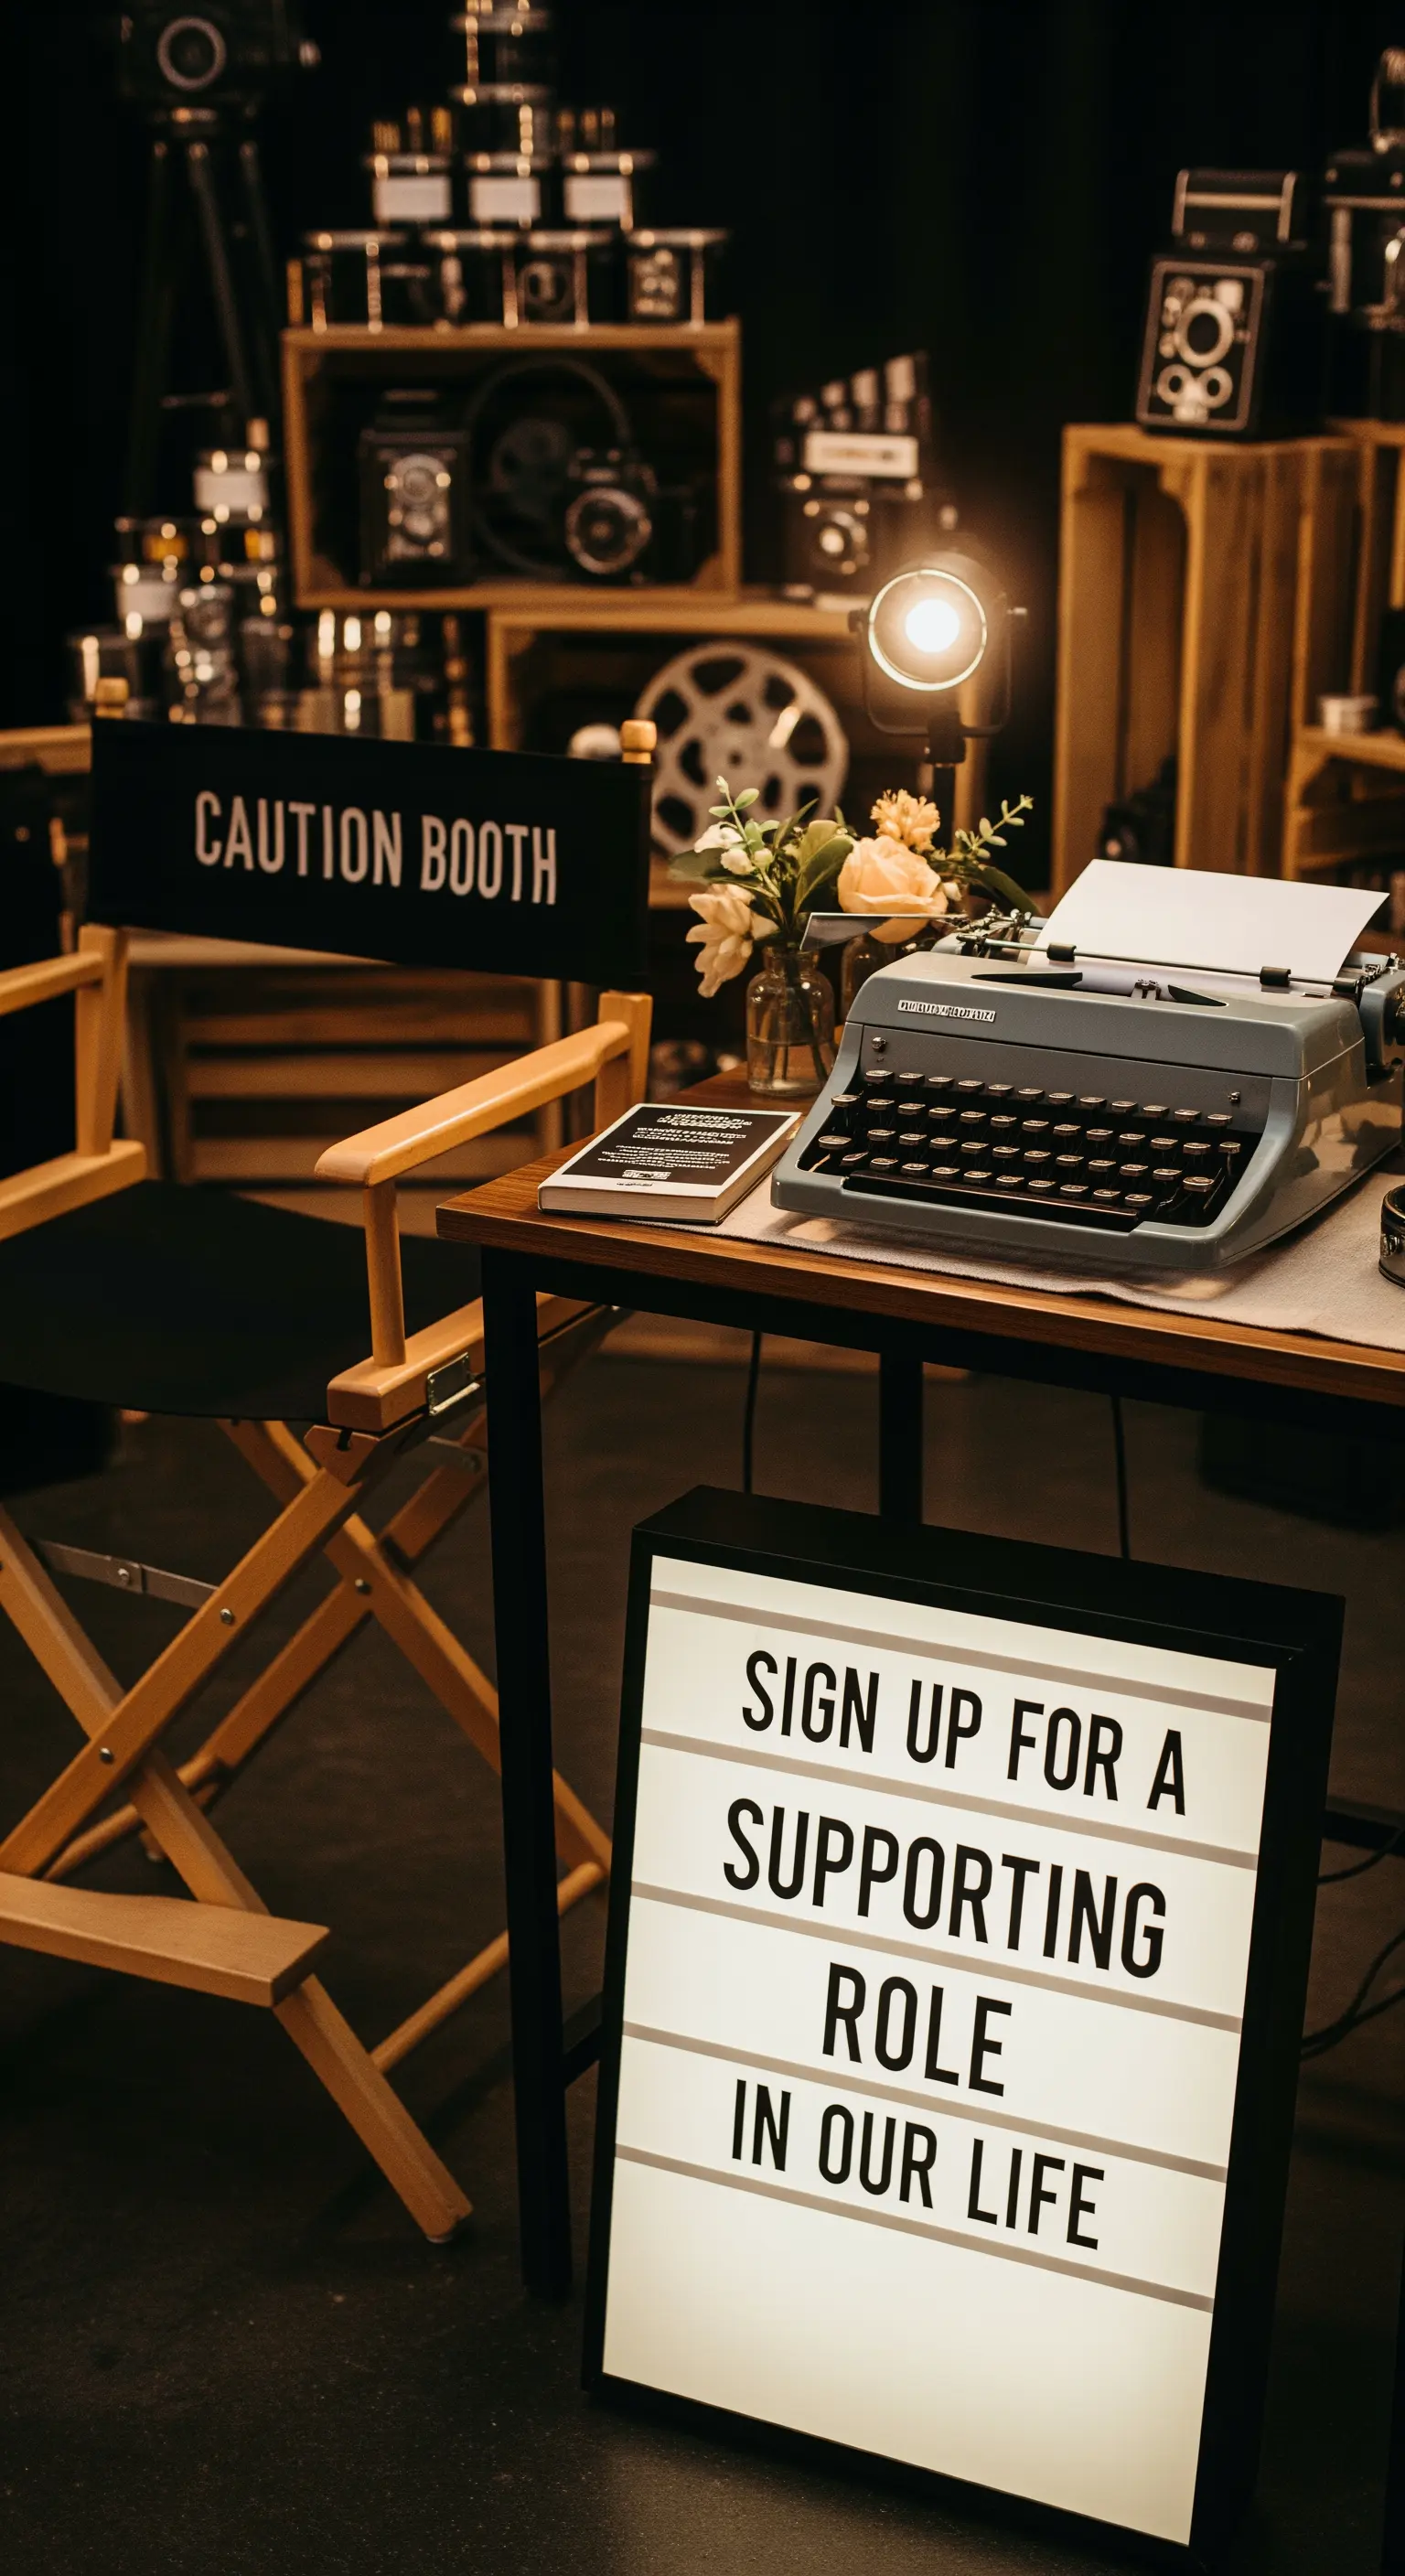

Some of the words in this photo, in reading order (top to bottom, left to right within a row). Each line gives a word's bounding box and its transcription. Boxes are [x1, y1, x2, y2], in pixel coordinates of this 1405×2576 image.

[195, 790, 402, 887] CAUTION
[420, 814, 556, 905] BOOTH
[742, 1649, 880, 1754] SIGN
[906, 1679, 983, 1769] UP
[1007, 1698, 1123, 1802] FOR
[1146, 1728, 1186, 1816] A
[723, 1798, 1167, 1979] SUPPORTING
[822, 1961, 1013, 2098] ROLE
[732, 2078, 792, 2172] IN
[818, 2104, 938, 2209] OUR
[967, 2138, 1105, 2250] LIFE
